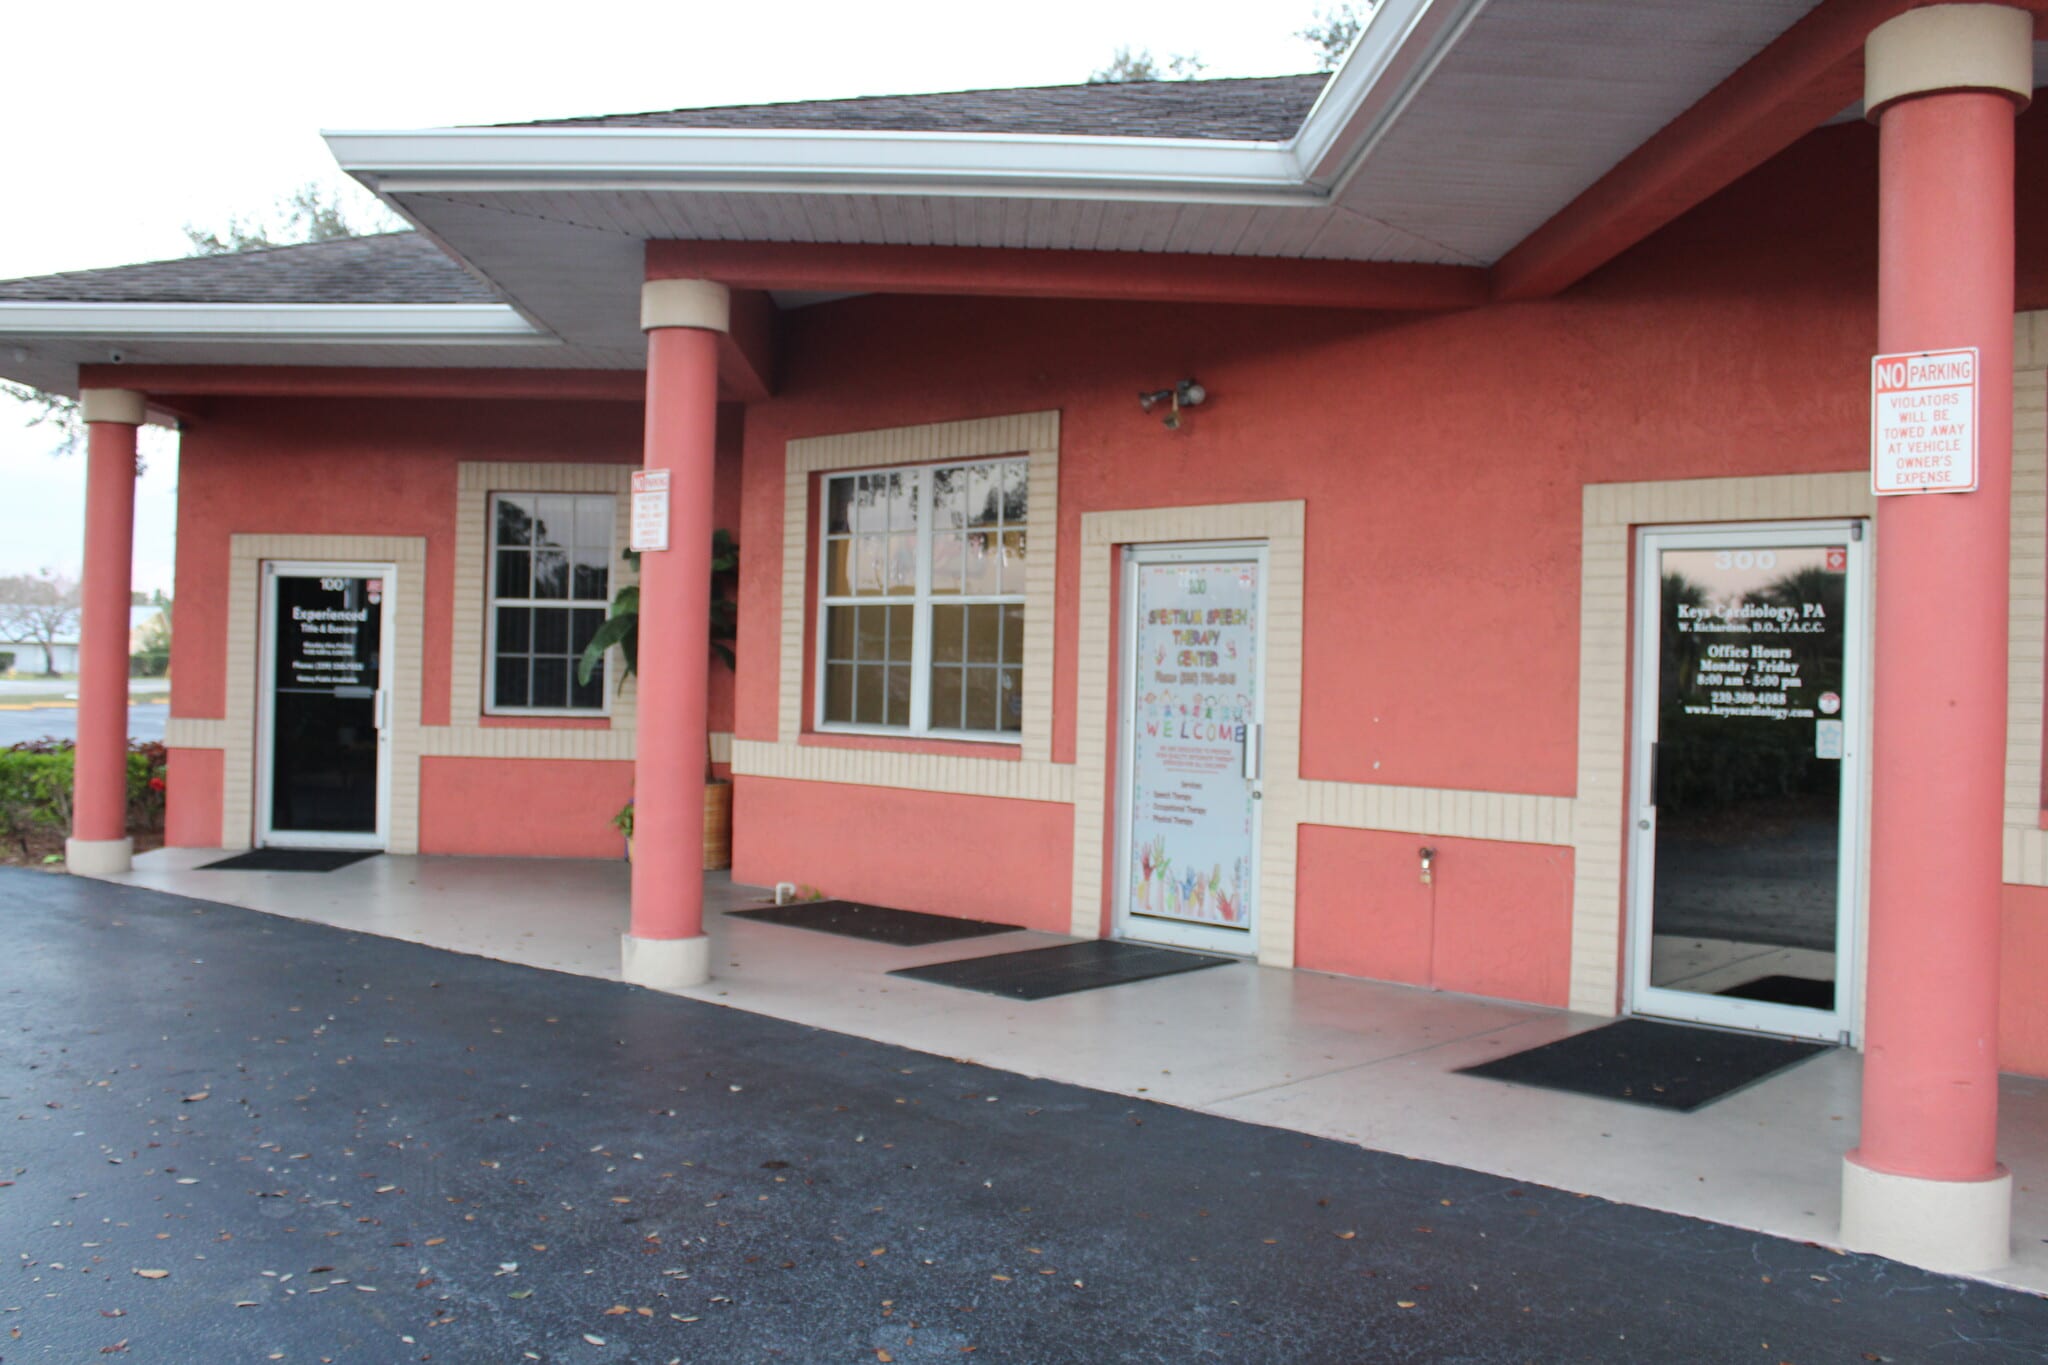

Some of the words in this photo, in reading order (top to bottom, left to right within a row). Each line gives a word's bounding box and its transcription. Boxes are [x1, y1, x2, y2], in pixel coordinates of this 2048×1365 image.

[1877, 362, 1906, 389] NO
[1910, 361, 1970, 382] PARKING
[1890, 393, 1959, 408] VIOLATORS
[1899, 412, 1927, 423] WILL
[1933, 409, 1950, 421] BE
[1884, 426, 1925, 440] TOWED
[1930, 424, 1965, 436] AWAY
[1888, 443, 1902, 454] AT
[1907, 440, 1960, 453] VEHICLE
[1896, 455, 1952, 469] OWNER'S
[1896, 470, 1952, 485] EXPENSE
[1714, 550, 1777, 570] 300
[320, 578, 344, 591] 100
[292, 606, 367, 622] Experienced
[1148, 608, 1202, 625] SPECTRUM
[1207, 608, 1248, 626] SPEECH
[1677, 604, 1711, 622] Keys
[1714, 604, 1799, 622] Cardiology,
[1802, 603, 1826, 618] PA
[1172, 629, 1221, 646] THERAPY
[1177, 650, 1218, 667] CENTER
[1707, 645, 1749, 659] Office
[1751, 645, 1792, 659] Hours
[1700, 659, 1749, 676] Monday
[1757, 660, 1799, 676] Friday
[1697, 673, 1723, 686] 8:00
[1724, 675, 1744, 687] am
[1752, 674, 1779, 687] 5:00
[1781, 677, 1802, 690] pm
[1146, 720, 1245, 743] WELCOME
